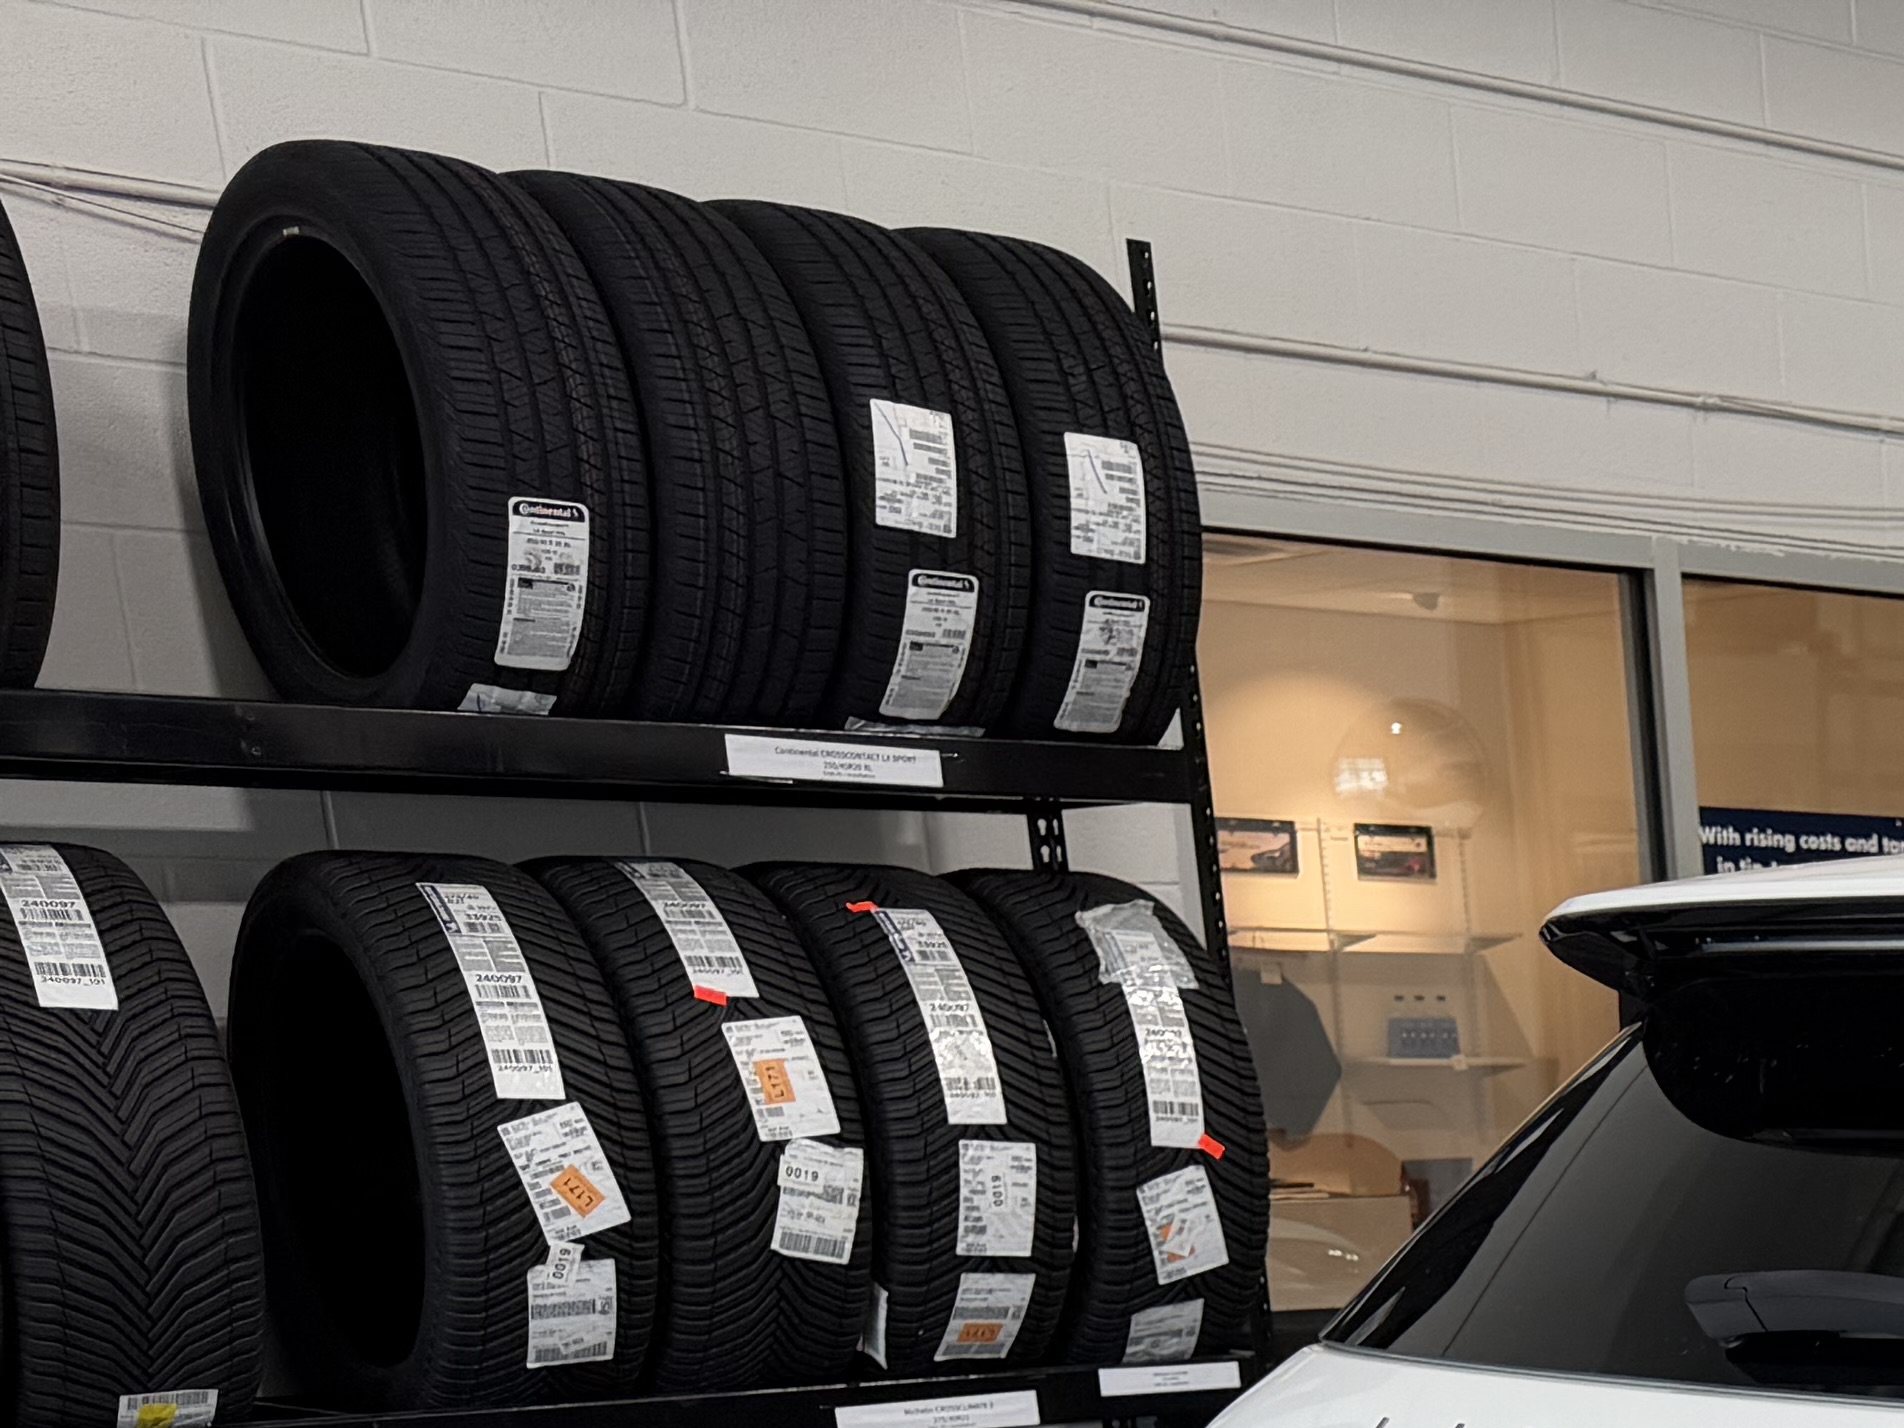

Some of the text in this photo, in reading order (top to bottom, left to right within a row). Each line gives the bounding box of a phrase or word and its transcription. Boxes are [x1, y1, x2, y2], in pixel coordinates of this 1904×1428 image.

[1699, 826, 1742, 848] With
[1745, 828, 1795, 853] rising
[1799, 833, 1841, 852] costs
[1844, 833, 1879, 853] and
[21, 900, 76, 908] 240097
[785, 1165, 820, 1182] 0019
